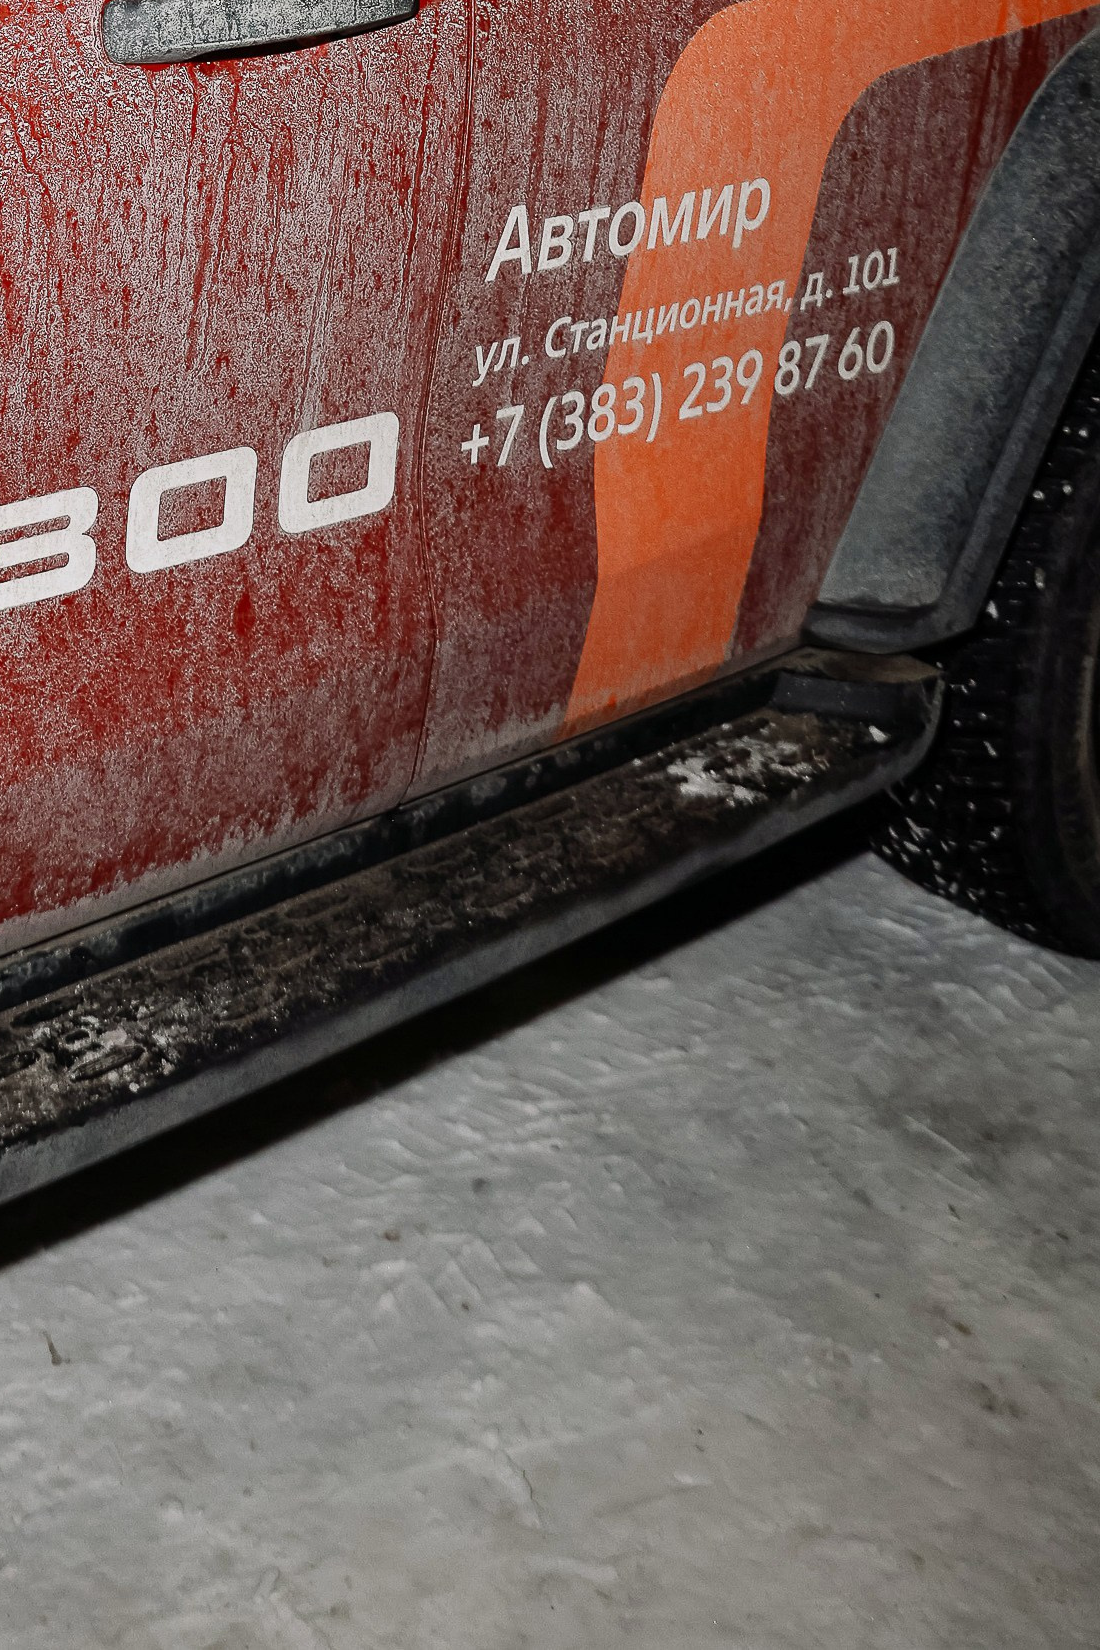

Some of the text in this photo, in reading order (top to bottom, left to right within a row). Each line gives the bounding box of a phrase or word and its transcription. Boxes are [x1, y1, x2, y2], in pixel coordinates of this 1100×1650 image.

[485, 176, 770, 282] Автомир
[472, 247, 899, 387] ул. Станционная, д. 101
[461, 321, 894, 469] +7 (383) 239 87 60
